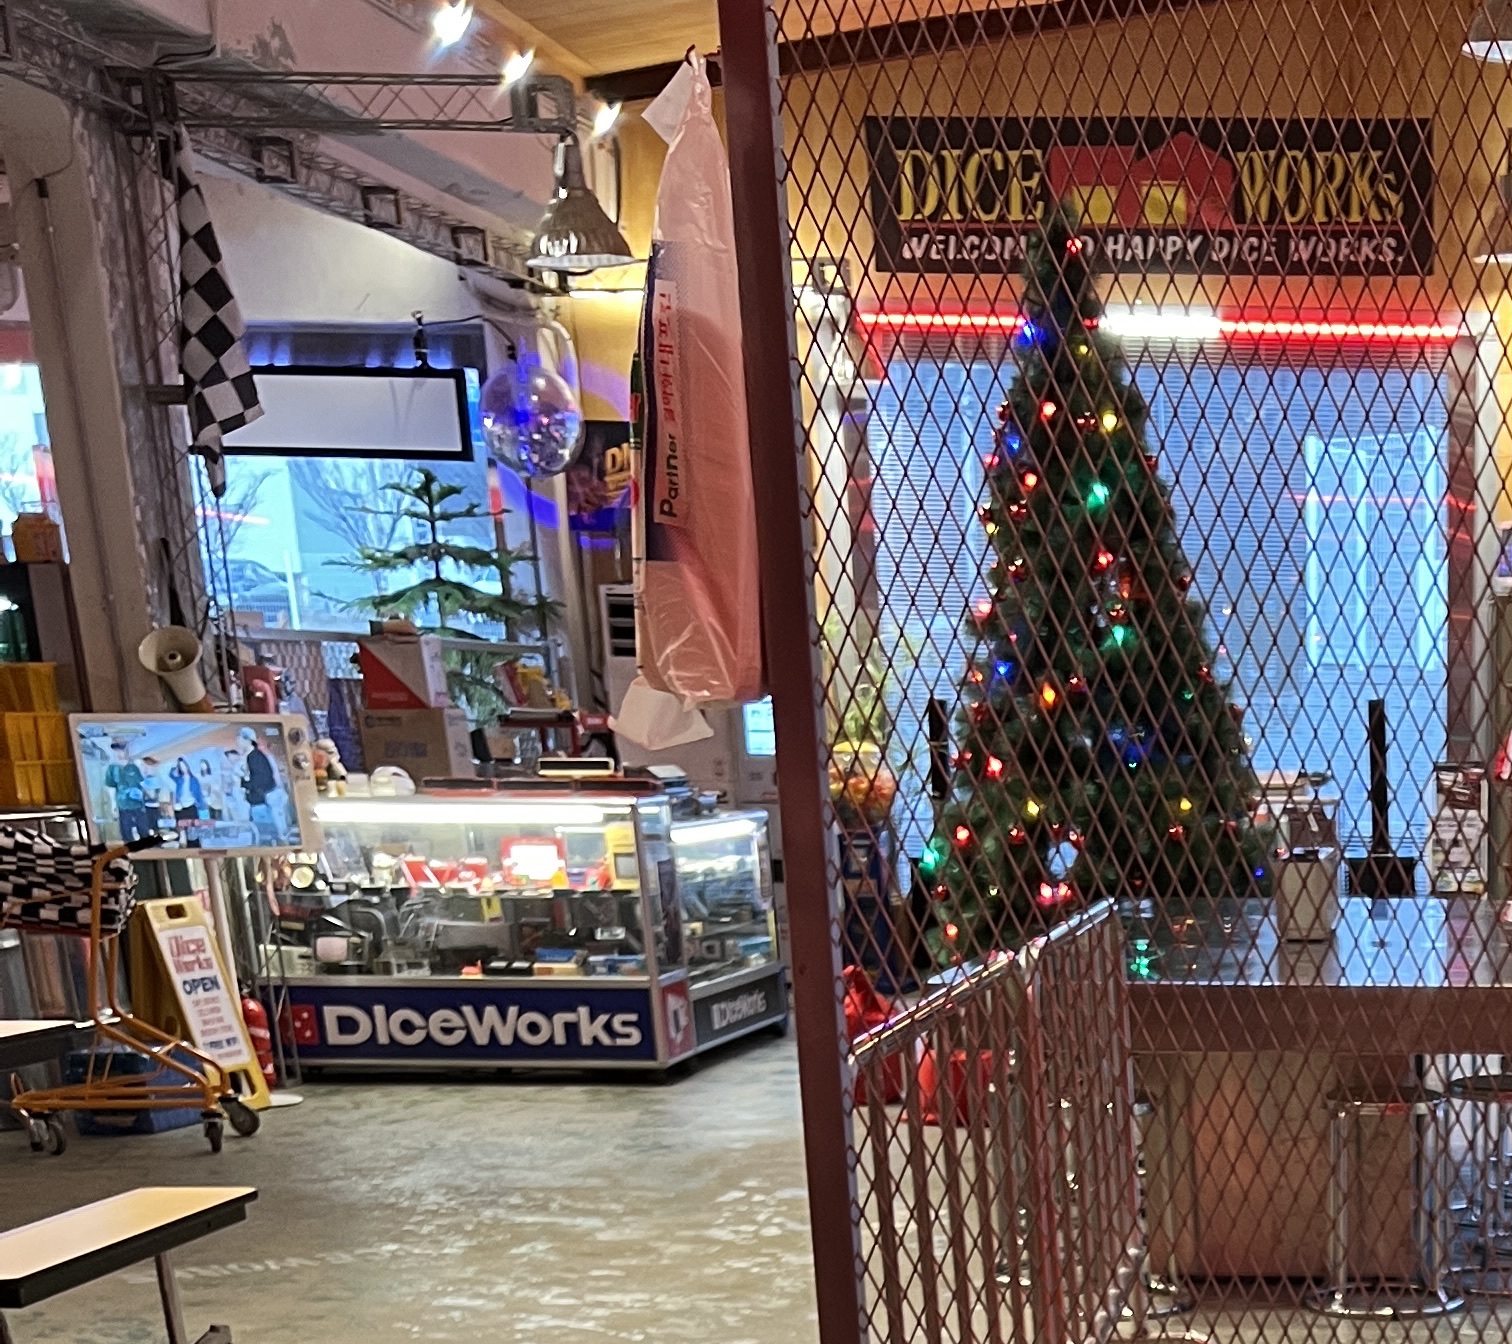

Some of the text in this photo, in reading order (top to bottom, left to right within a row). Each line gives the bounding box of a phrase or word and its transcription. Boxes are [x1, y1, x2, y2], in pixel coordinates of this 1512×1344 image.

[898, 148, 1045, 222] DICE
[900, 233, 1030, 262] WELCOM
[1104, 234, 1204, 263] HAPPY
[1210, 236, 1277, 263] DICE
[658, 433, 680, 518] Partner
[182, 974, 220, 995] OPEN
